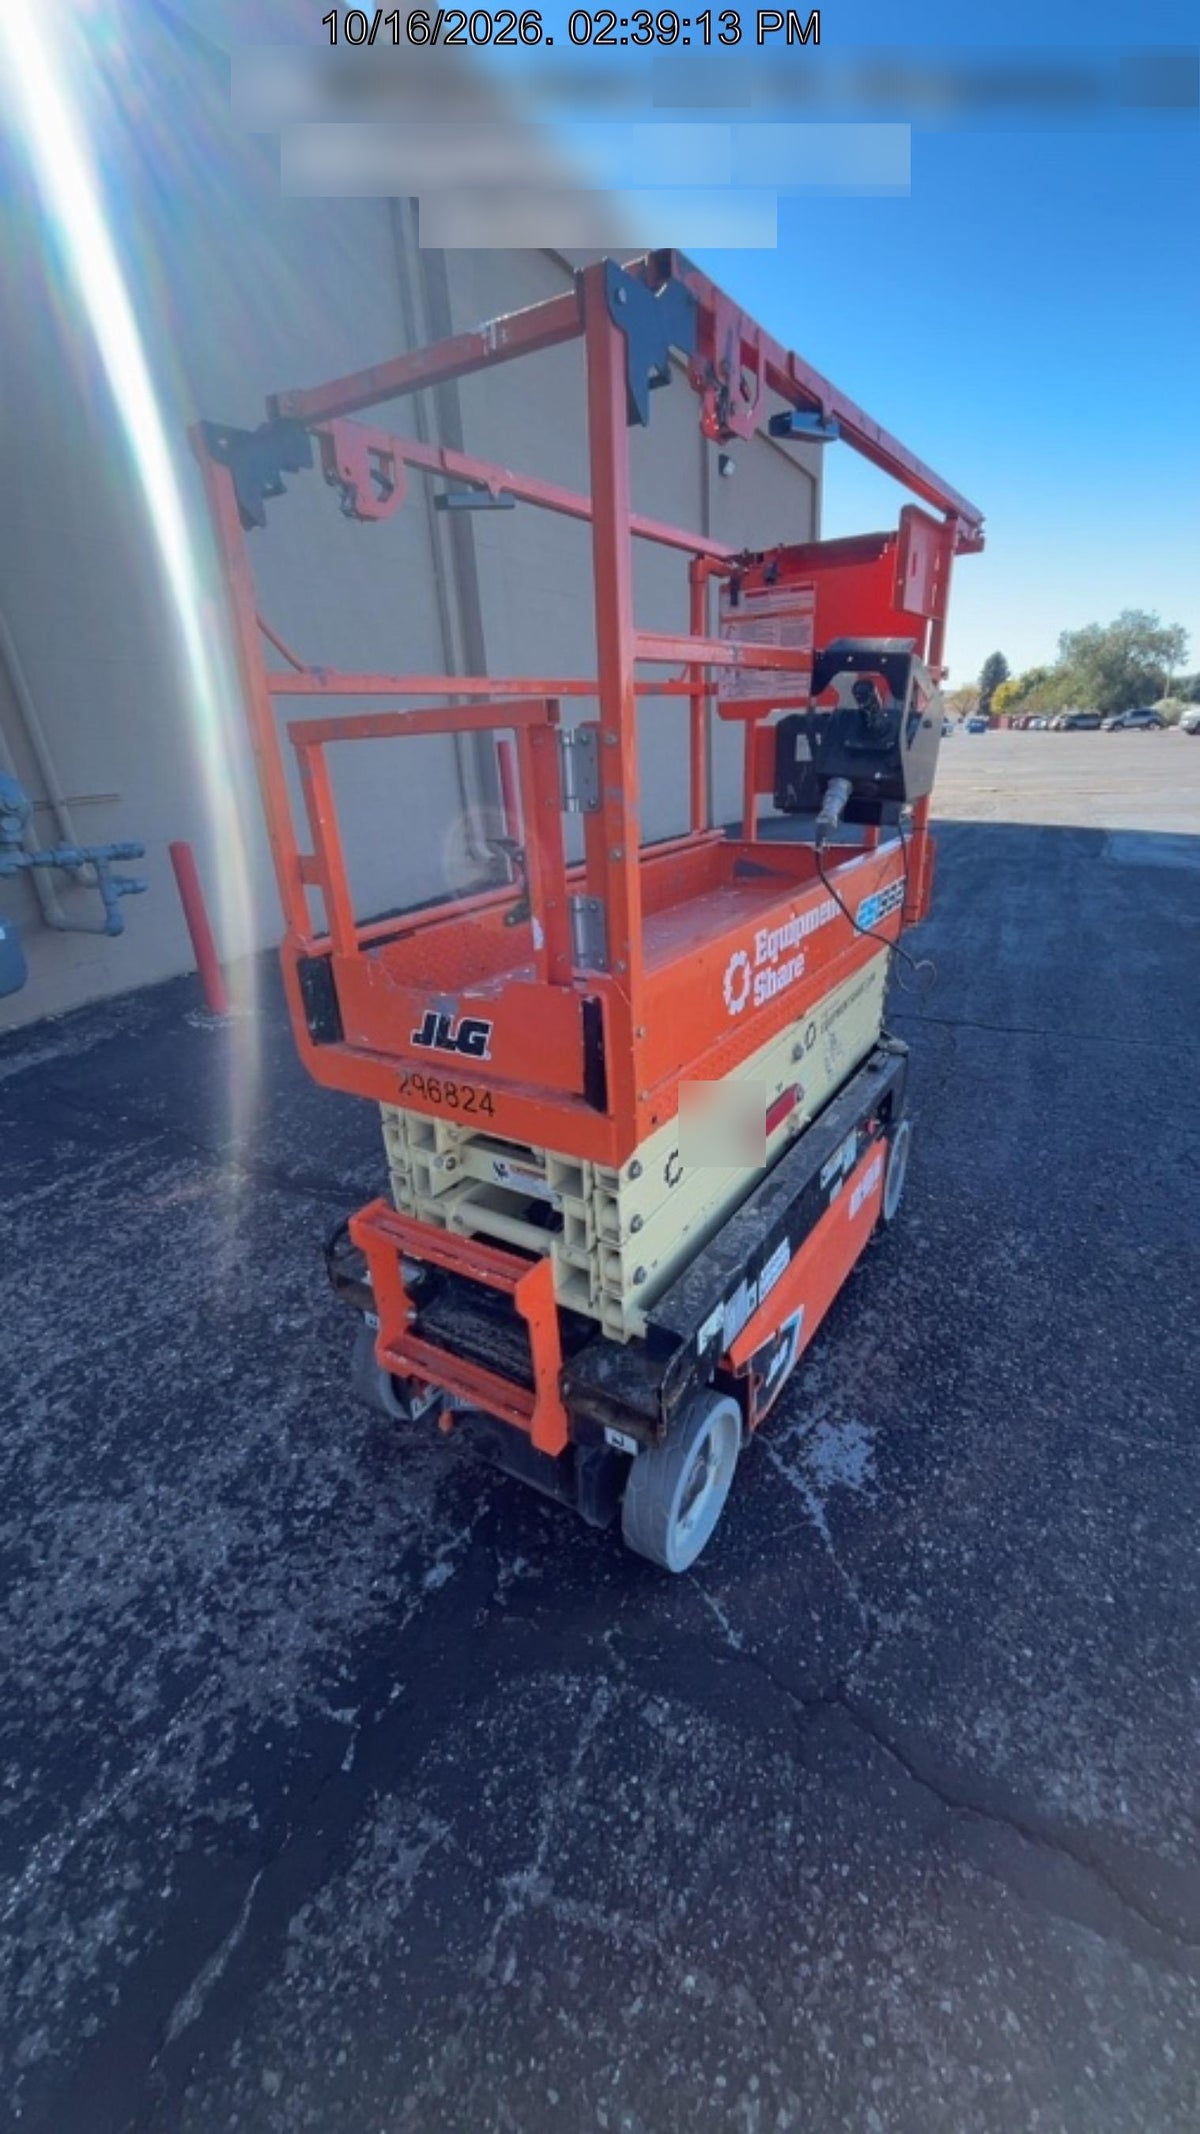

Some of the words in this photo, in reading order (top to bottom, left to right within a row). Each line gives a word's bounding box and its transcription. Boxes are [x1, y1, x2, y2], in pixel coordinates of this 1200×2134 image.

[754, 889, 844, 965] Equipment
[753, 952, 805, 1007] Share
[411, 1010, 492, 1060] JLG
[398, 1070, 495, 1117] 296824
